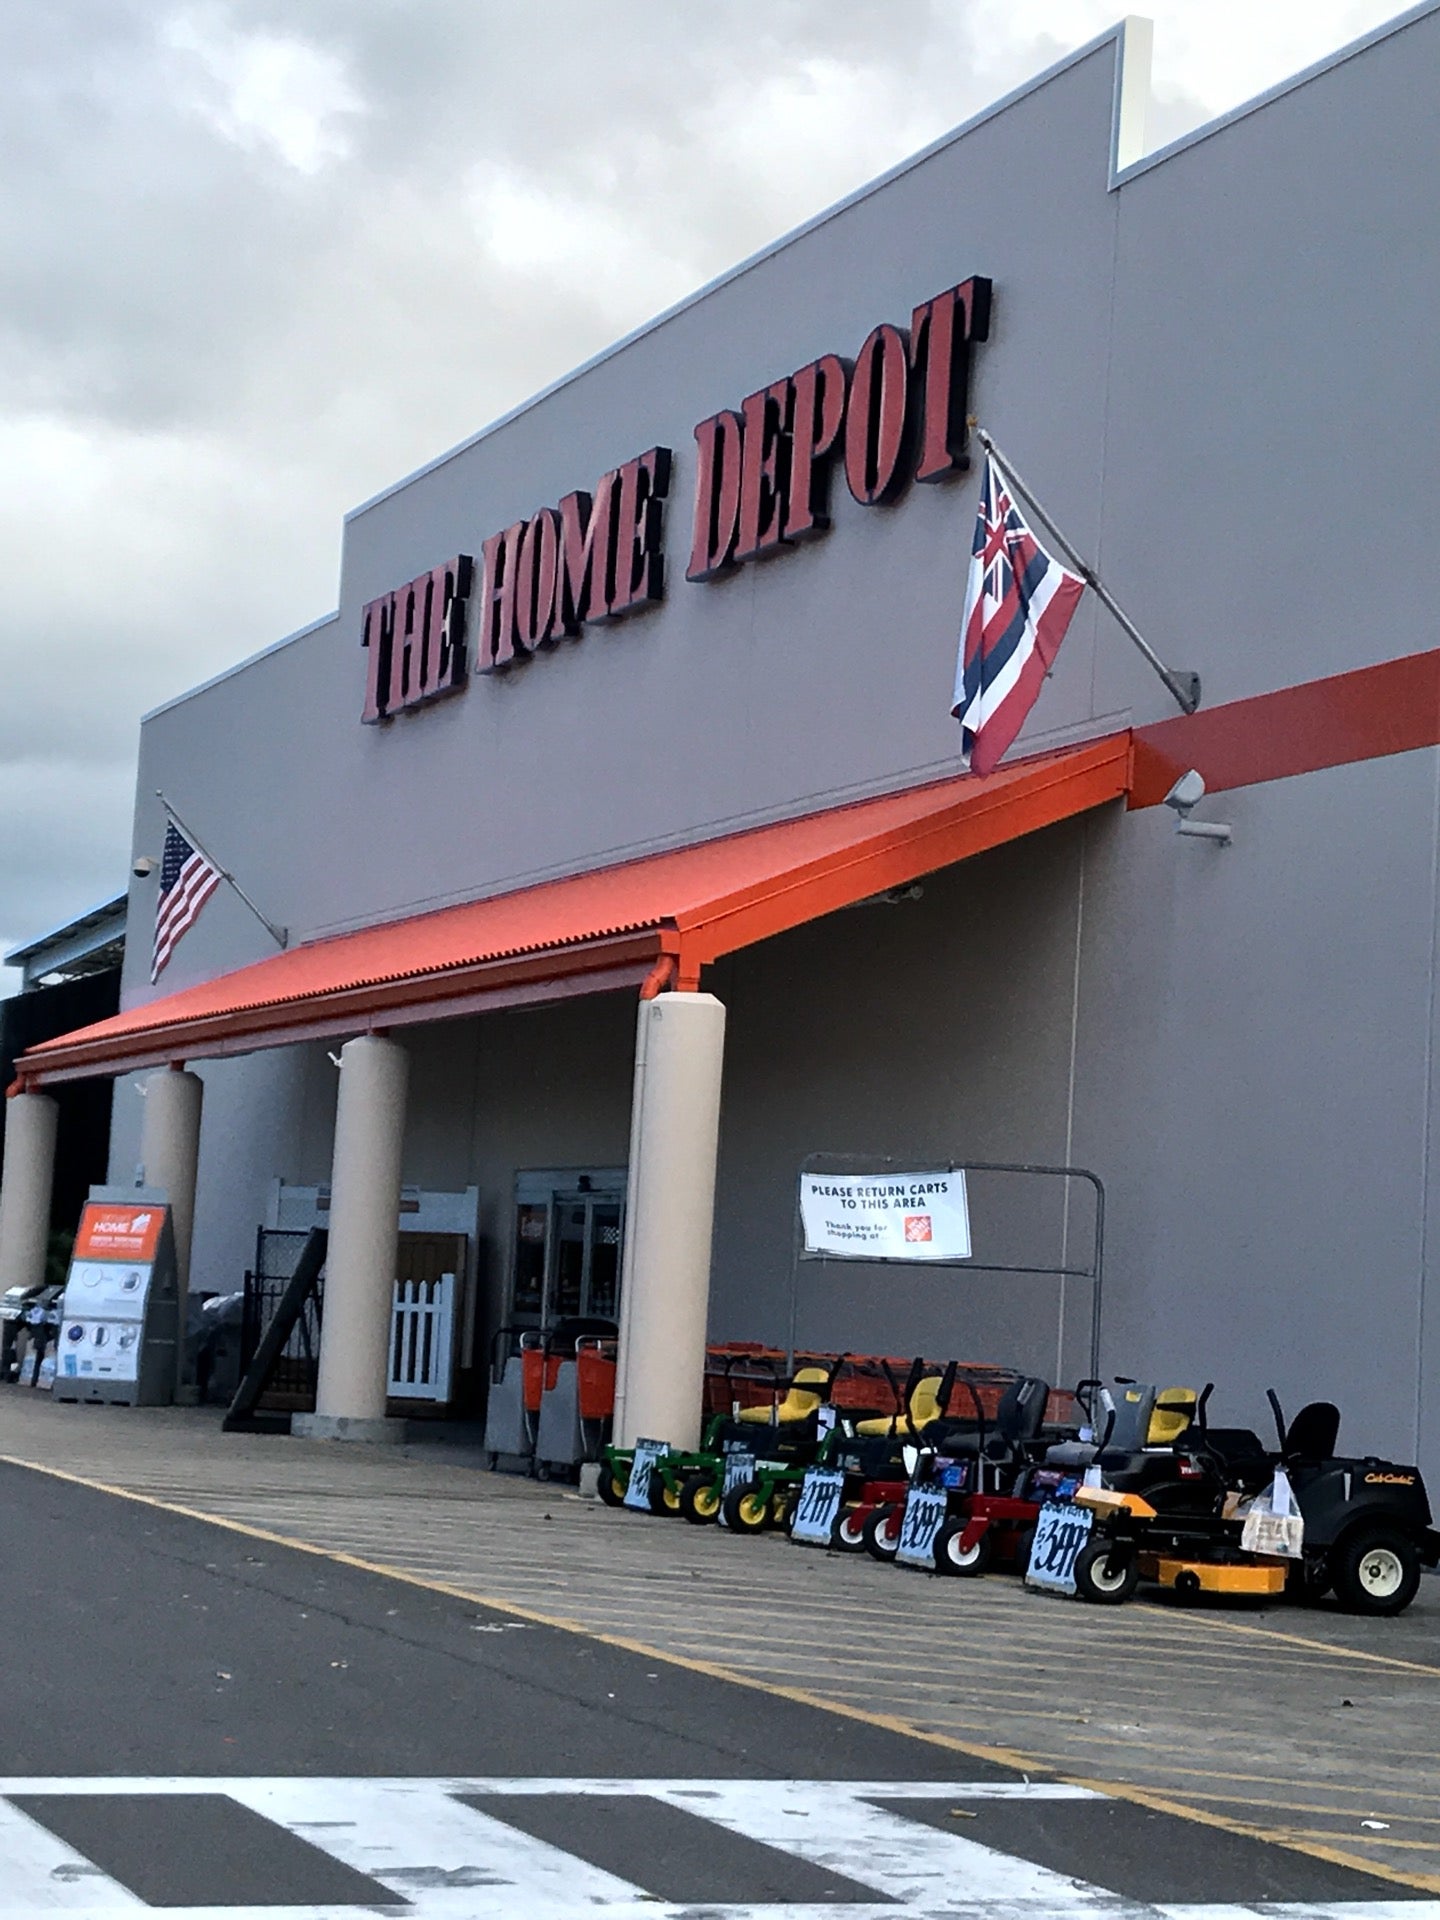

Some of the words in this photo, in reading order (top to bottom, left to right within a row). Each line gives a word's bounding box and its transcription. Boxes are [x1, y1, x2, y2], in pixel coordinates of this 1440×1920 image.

[361, 554, 472, 725] THE
[476, 447, 672, 674] HOME
[686, 275, 993, 582] DEPOT
[812, 1185, 852, 1197] PLEASE
[857, 1185, 905, 1197] RETURN
[909, 1182, 948, 1195] CARTS
[841, 1199, 857, 1209] TO
[861, 1198, 889, 1209] THIS
[893, 1197, 926, 1208] AREA
[93, 1222, 129, 1233] HOME
[825, 1221, 852, 1231] Thank
[855, 1224, 871, 1232] you
[827, 1230, 867, 1241] shopping
